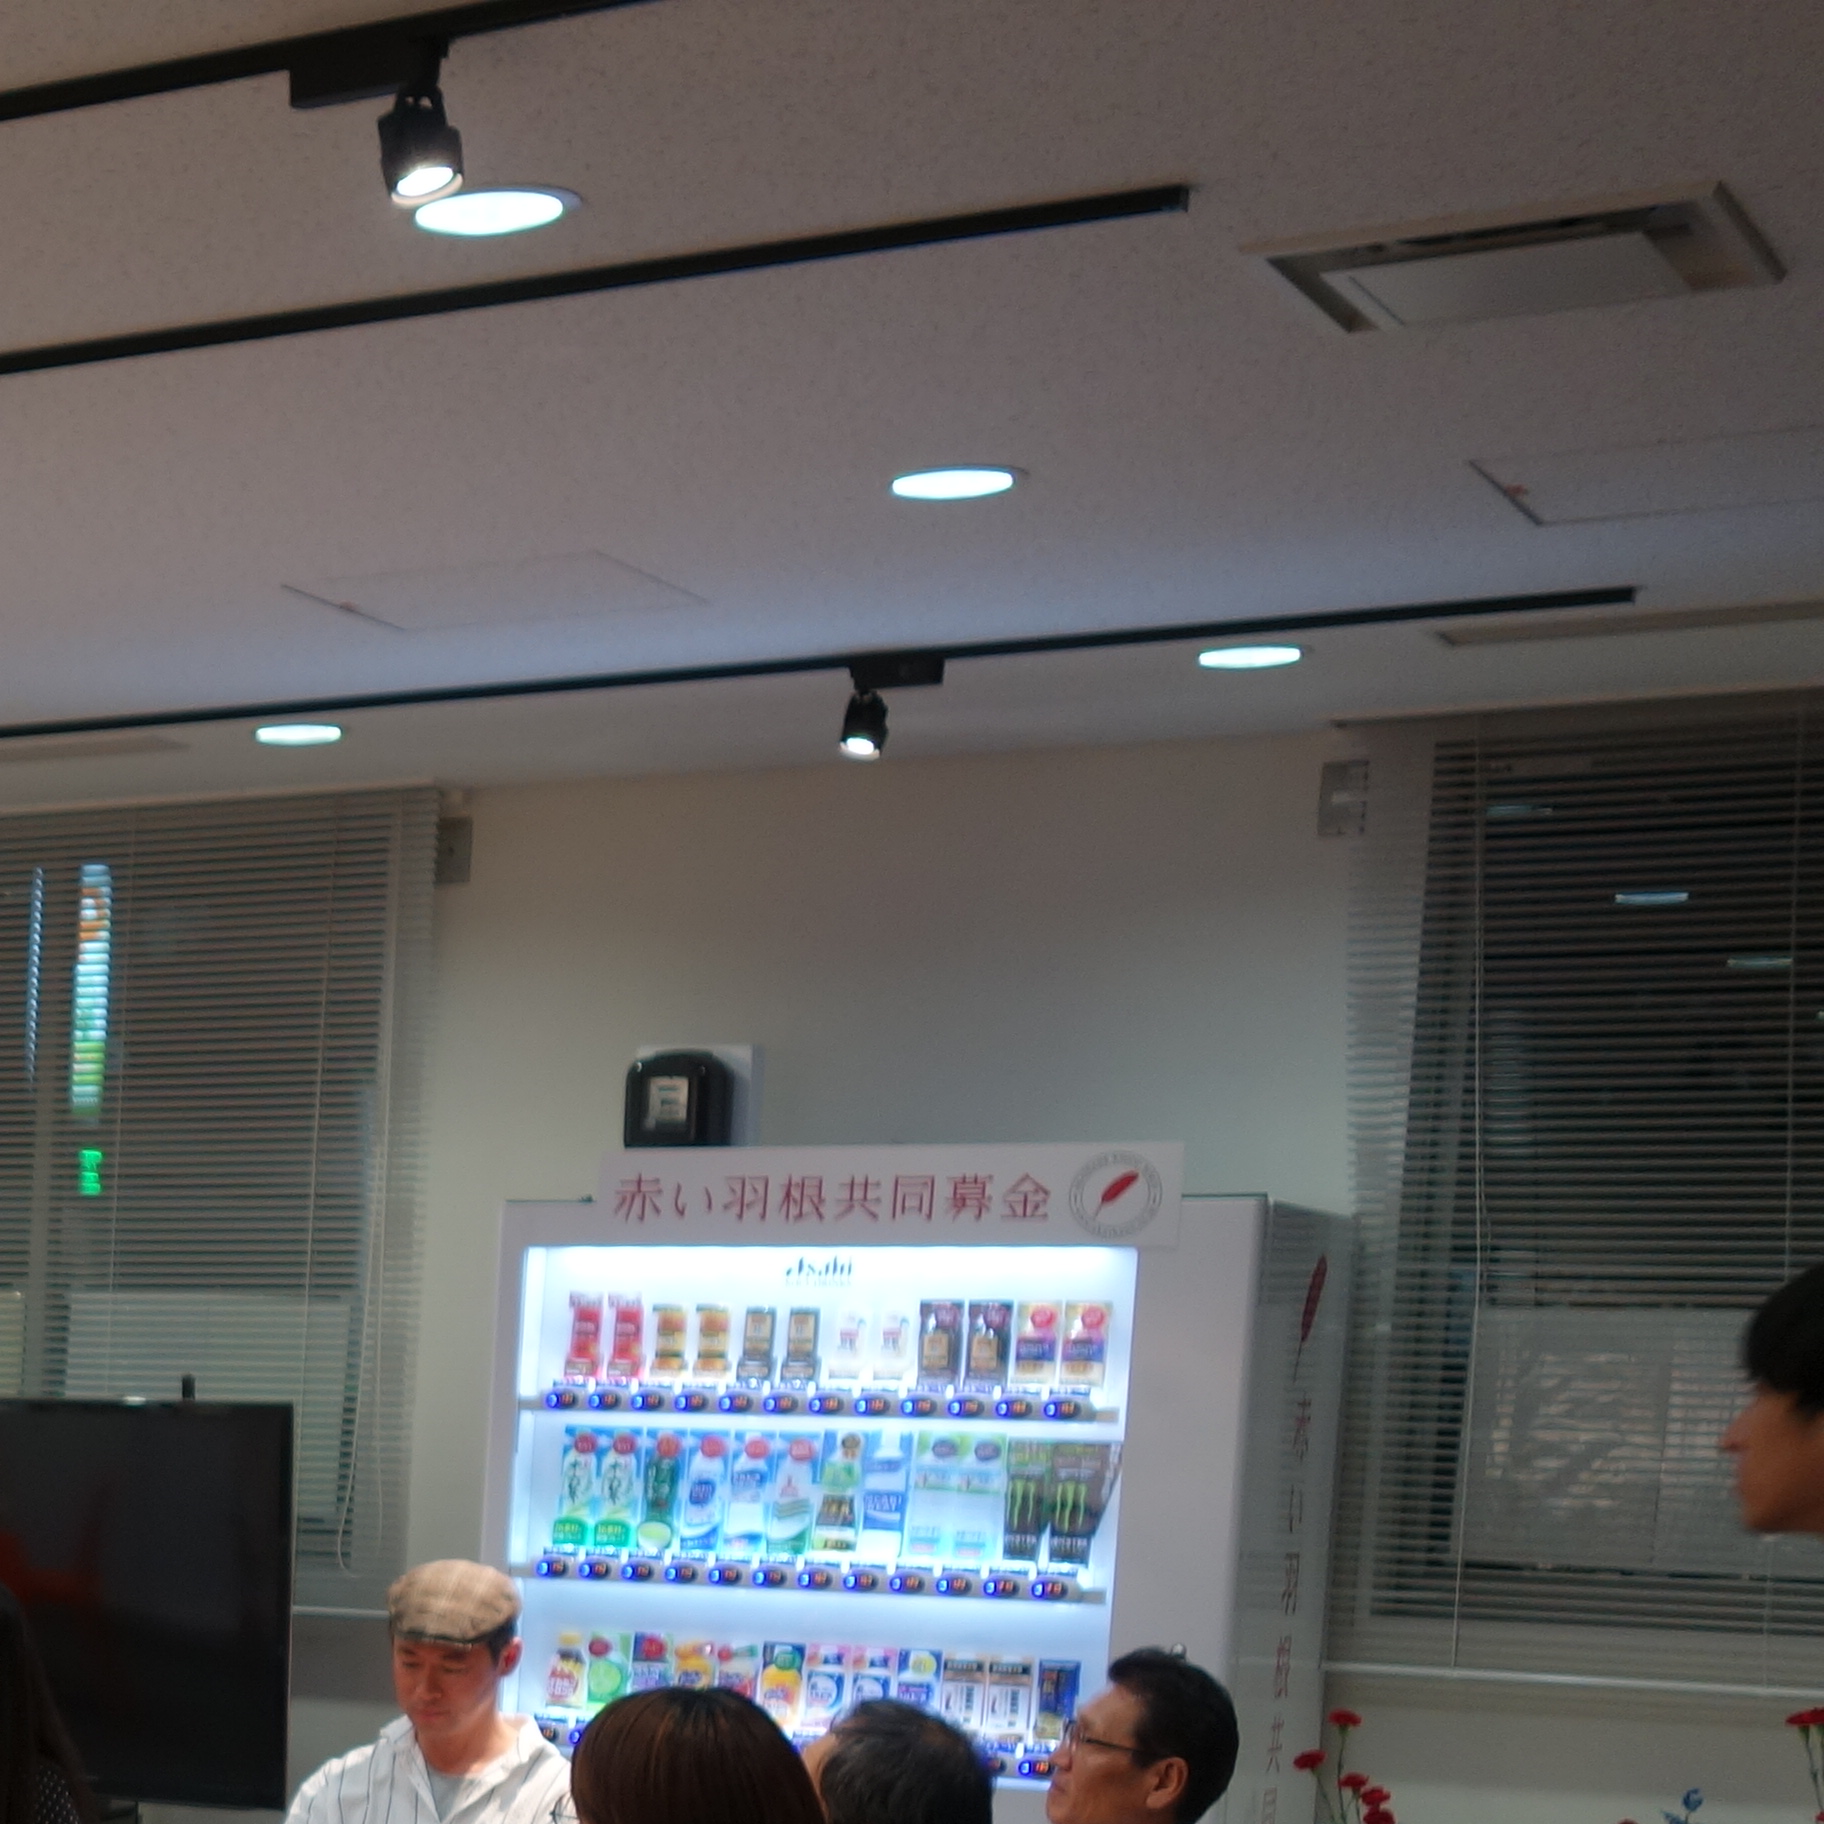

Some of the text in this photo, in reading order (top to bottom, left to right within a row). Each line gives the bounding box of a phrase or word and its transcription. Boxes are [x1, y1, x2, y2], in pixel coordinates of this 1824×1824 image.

[614, 1171, 1050, 1223] 赤い羽根共同募金
[786, 1255, 852, 1277] Asahi
